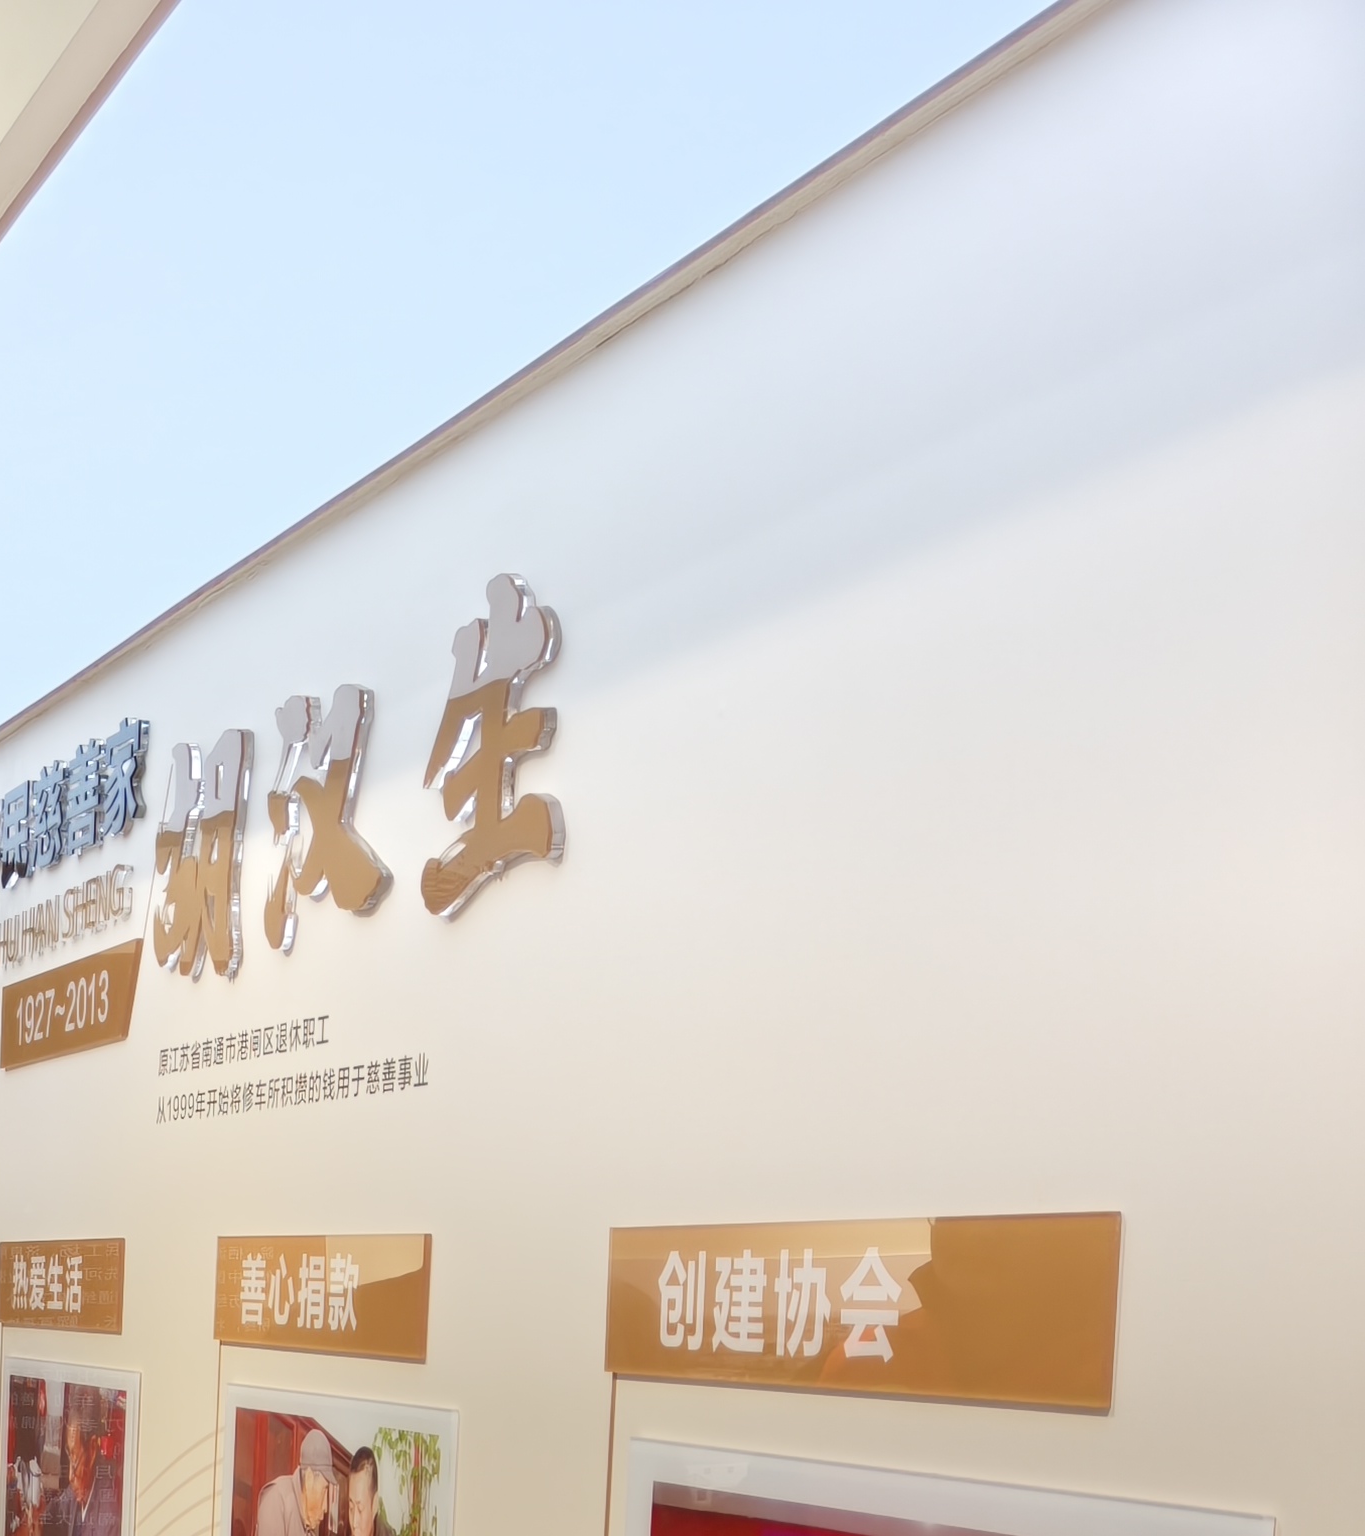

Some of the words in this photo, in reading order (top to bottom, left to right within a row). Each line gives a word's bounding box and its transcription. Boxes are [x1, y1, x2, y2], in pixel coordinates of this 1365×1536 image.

[153, 573, 566, 983] 胡汉生
[16, 970, 110, 1046] 1927~2013
[158, 1015, 330, 1077] 原江苏省南通市港闸区退休职工
[12, 1253, 83, 1314] 热爱生活
[240, 1252, 360, 1332] 善心捐款
[657, 1246, 903, 1363] 创建协会
